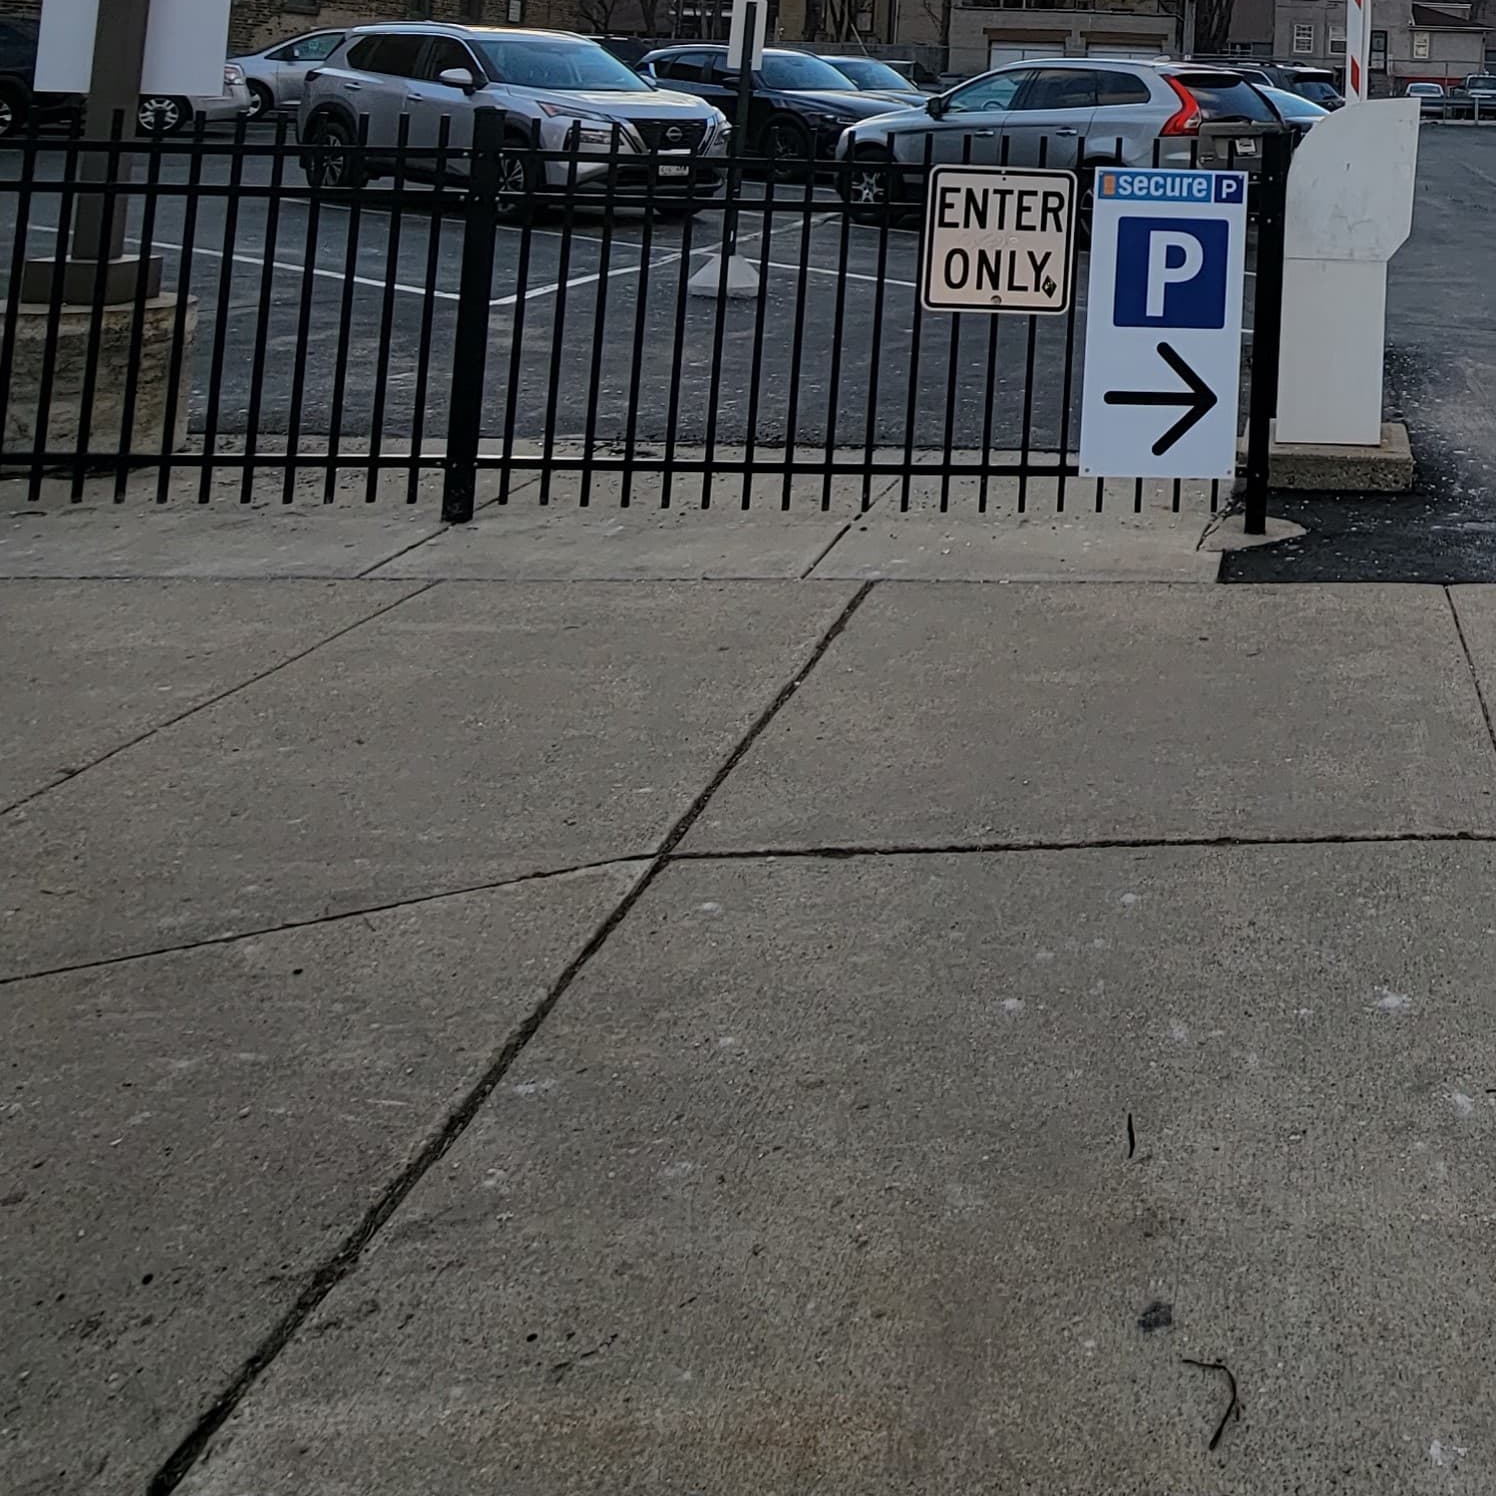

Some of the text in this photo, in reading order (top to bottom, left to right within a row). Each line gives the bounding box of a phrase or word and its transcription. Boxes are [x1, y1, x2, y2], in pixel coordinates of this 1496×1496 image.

[937, 186, 1065, 232] ENTER
[1118, 175, 1237, 199] secure P
[944, 247, 1052, 293] ONLY
[1146, 230, 1204, 317] P
